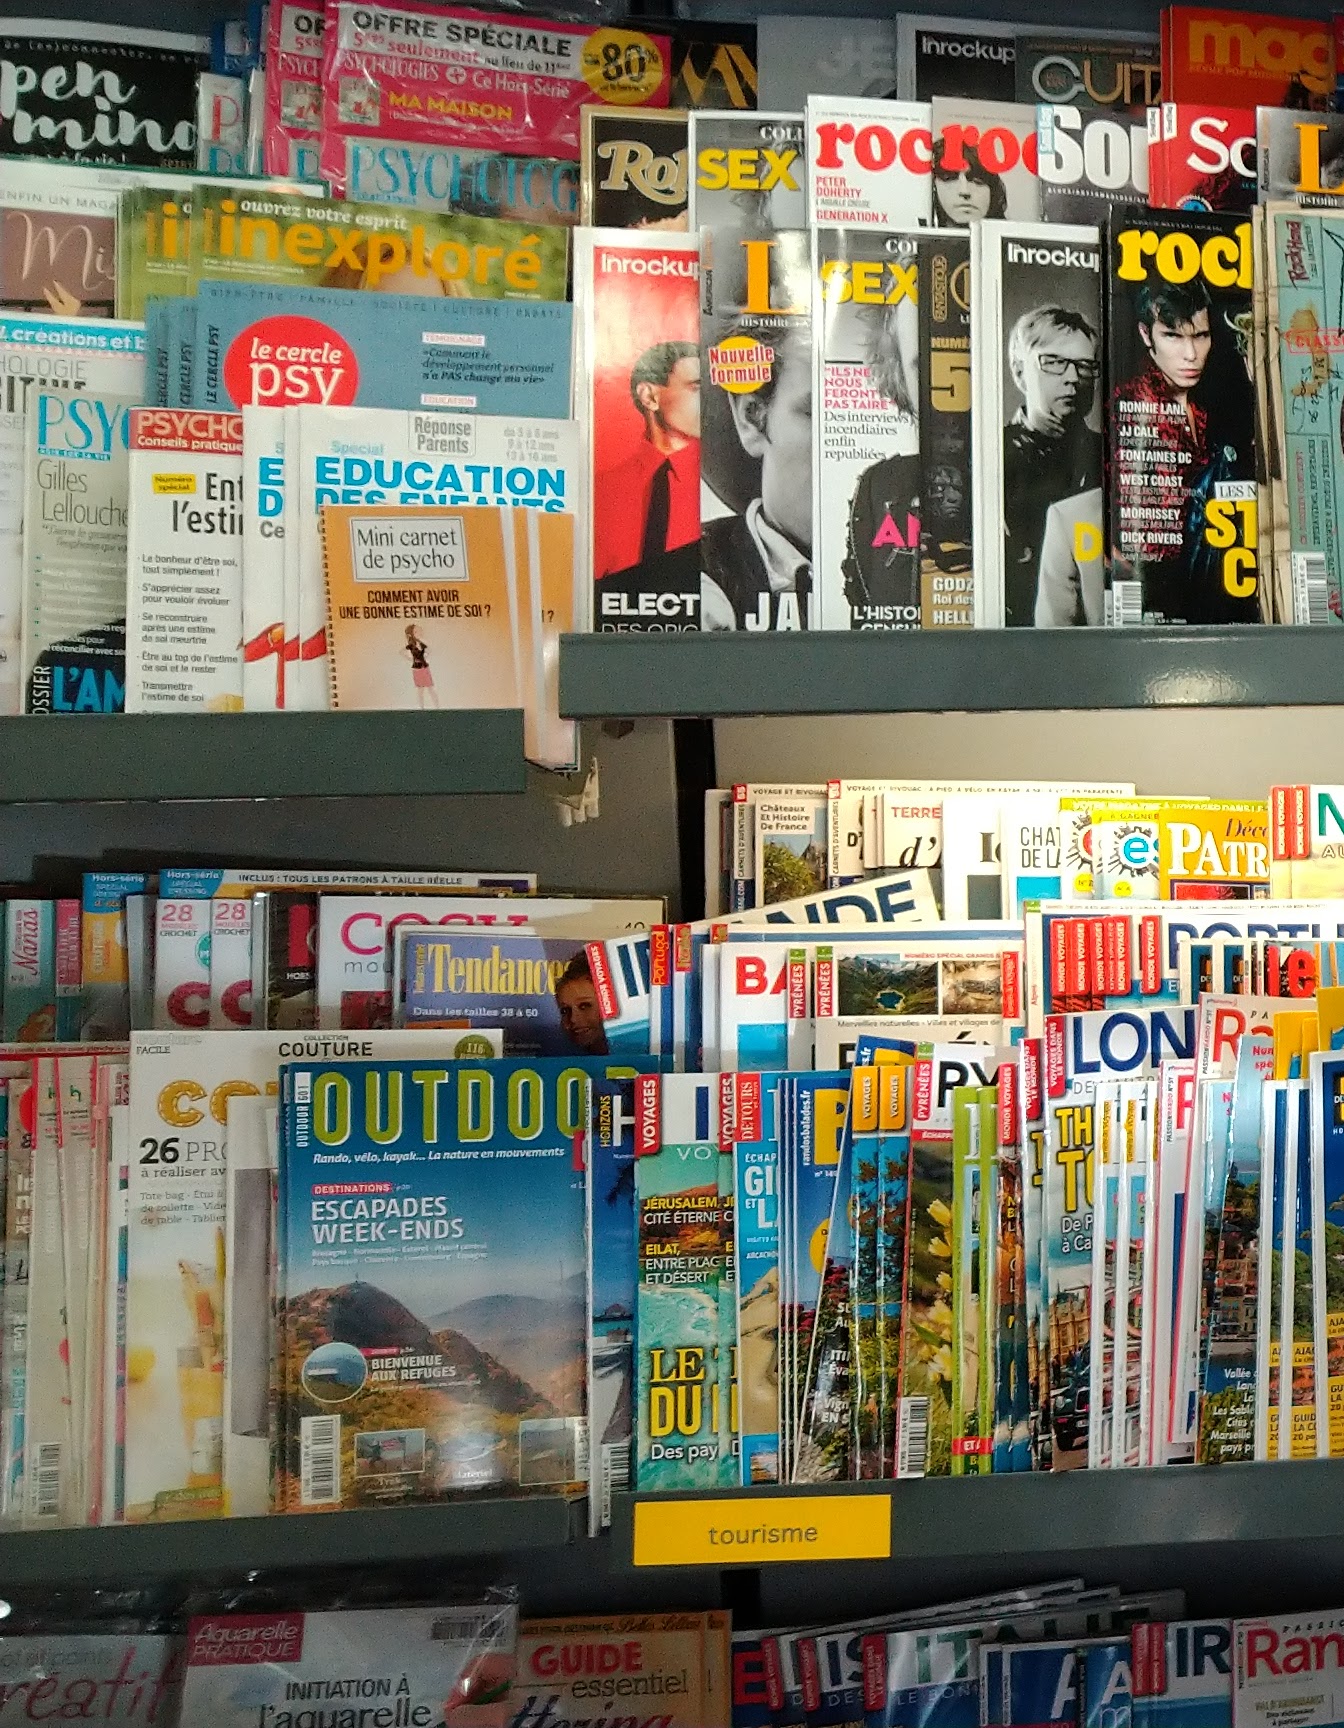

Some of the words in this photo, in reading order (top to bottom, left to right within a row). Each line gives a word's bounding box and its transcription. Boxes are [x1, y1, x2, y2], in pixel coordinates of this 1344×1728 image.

[352, 9, 437, 40] OFFRE
[445, 21, 572, 58] SPÉCIALE
[428, 95, 514, 121] MAISON
[698, 149, 800, 190] SEX
[241, 199, 300, 218] ouvrez
[306, 205, 350, 225] votre
[355, 211, 409, 231] esprit
[220, 199, 542, 289] inexploré
[275, 341, 342, 365] cercle
[710, 346, 774, 364] Nouvelle
[711, 365, 771, 384] formule
[414, 416, 471, 437] Réponse
[416, 435, 469, 454] Parents
[37, 459, 88, 493] Gilles
[315, 456, 566, 497] EDUCATION
[357, 528, 392, 547] Mini
[397, 531, 457, 547] carnet
[362, 551, 386, 568] de
[390, 552, 455, 574] psycho
[278, 1041, 373, 1057] COUTURE
[916, 1061, 933, 1121] PYRÉNÉES
[139, 1138, 179, 1164] 26
[311, 1197, 447, 1221] ESCAPADES
[311, 1220, 464, 1244] WEEK-ENDS
[649, 1348, 707, 1382] LE
[649, 1385, 701, 1438] DU
[709, 1522, 819, 1546] tourisme
[530, 1639, 643, 1677] GUIDE
[285, 1679, 391, 1701] INITIATION
[571, 1672, 688, 1698] essentiel
